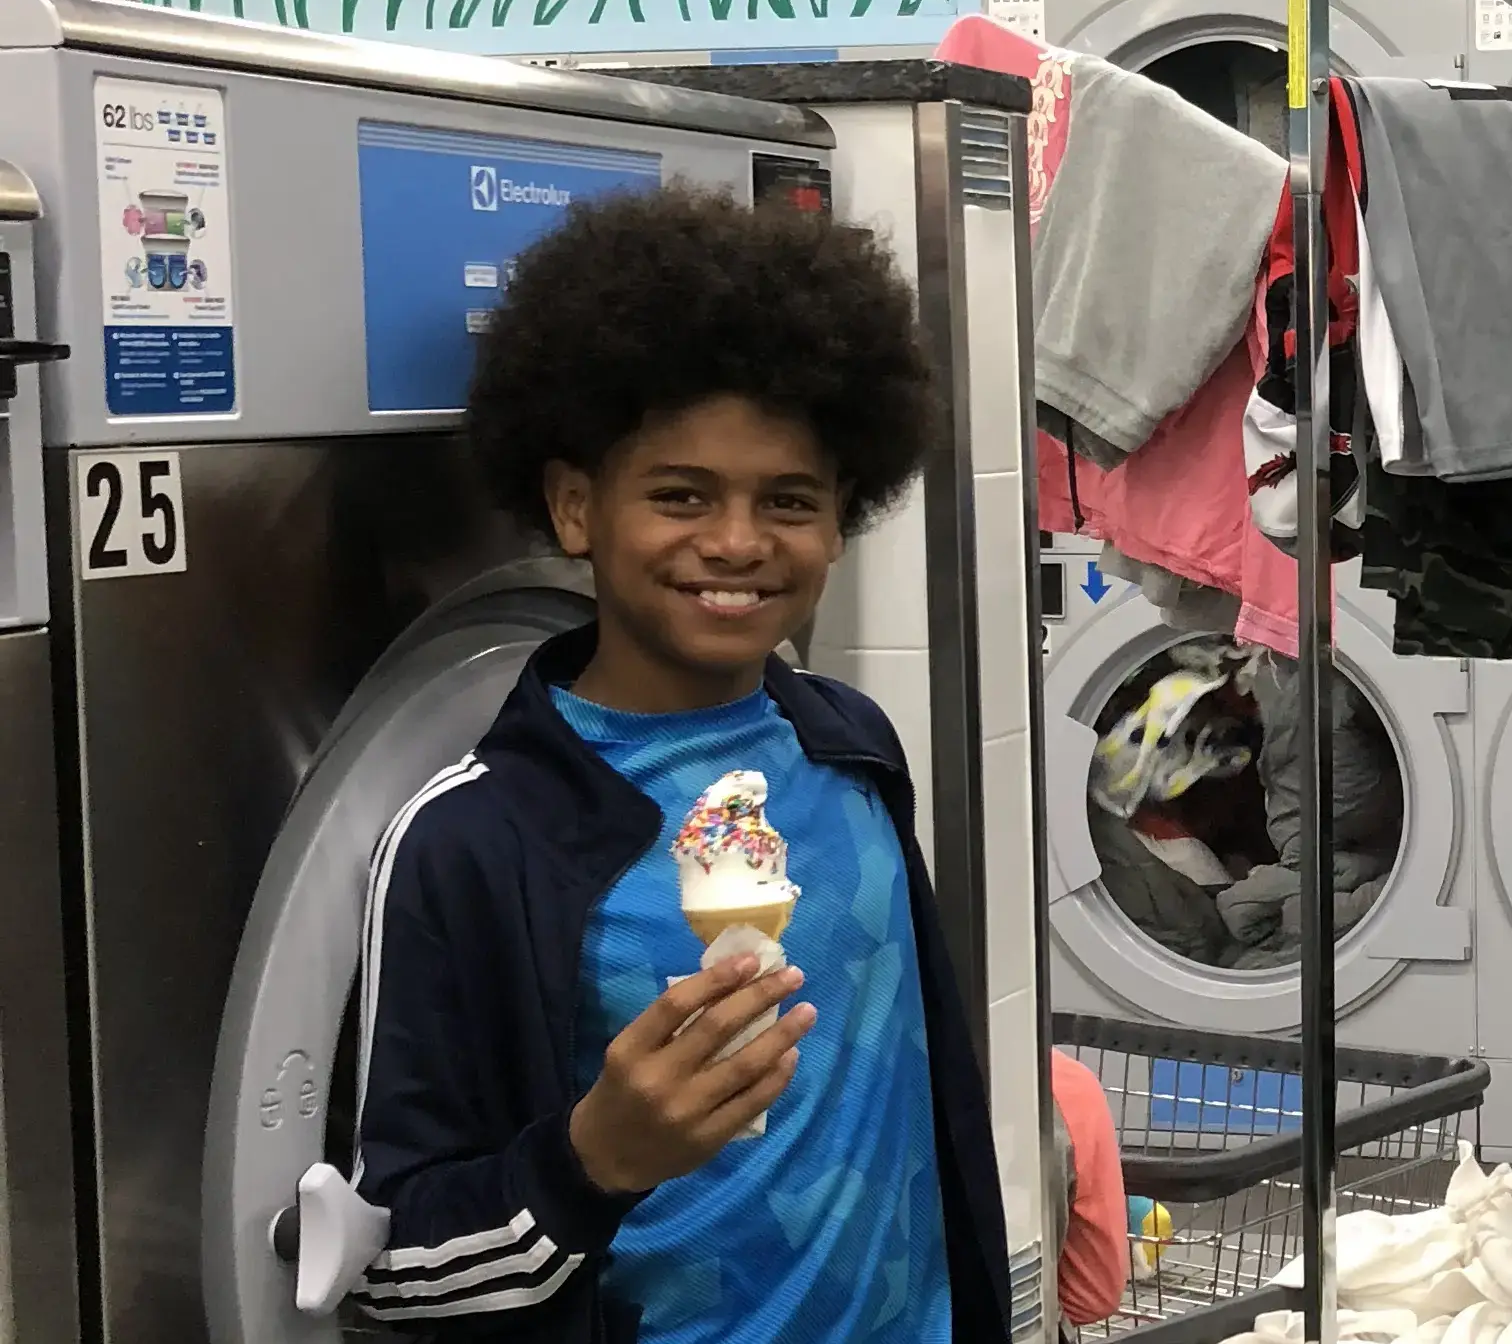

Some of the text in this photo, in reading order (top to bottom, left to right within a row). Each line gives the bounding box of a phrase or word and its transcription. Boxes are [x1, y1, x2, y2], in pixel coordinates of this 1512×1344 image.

[102, 103, 154, 131] 62 lbs
[500, 178, 571, 206] Electrolux
[85, 460, 176, 569] 25
